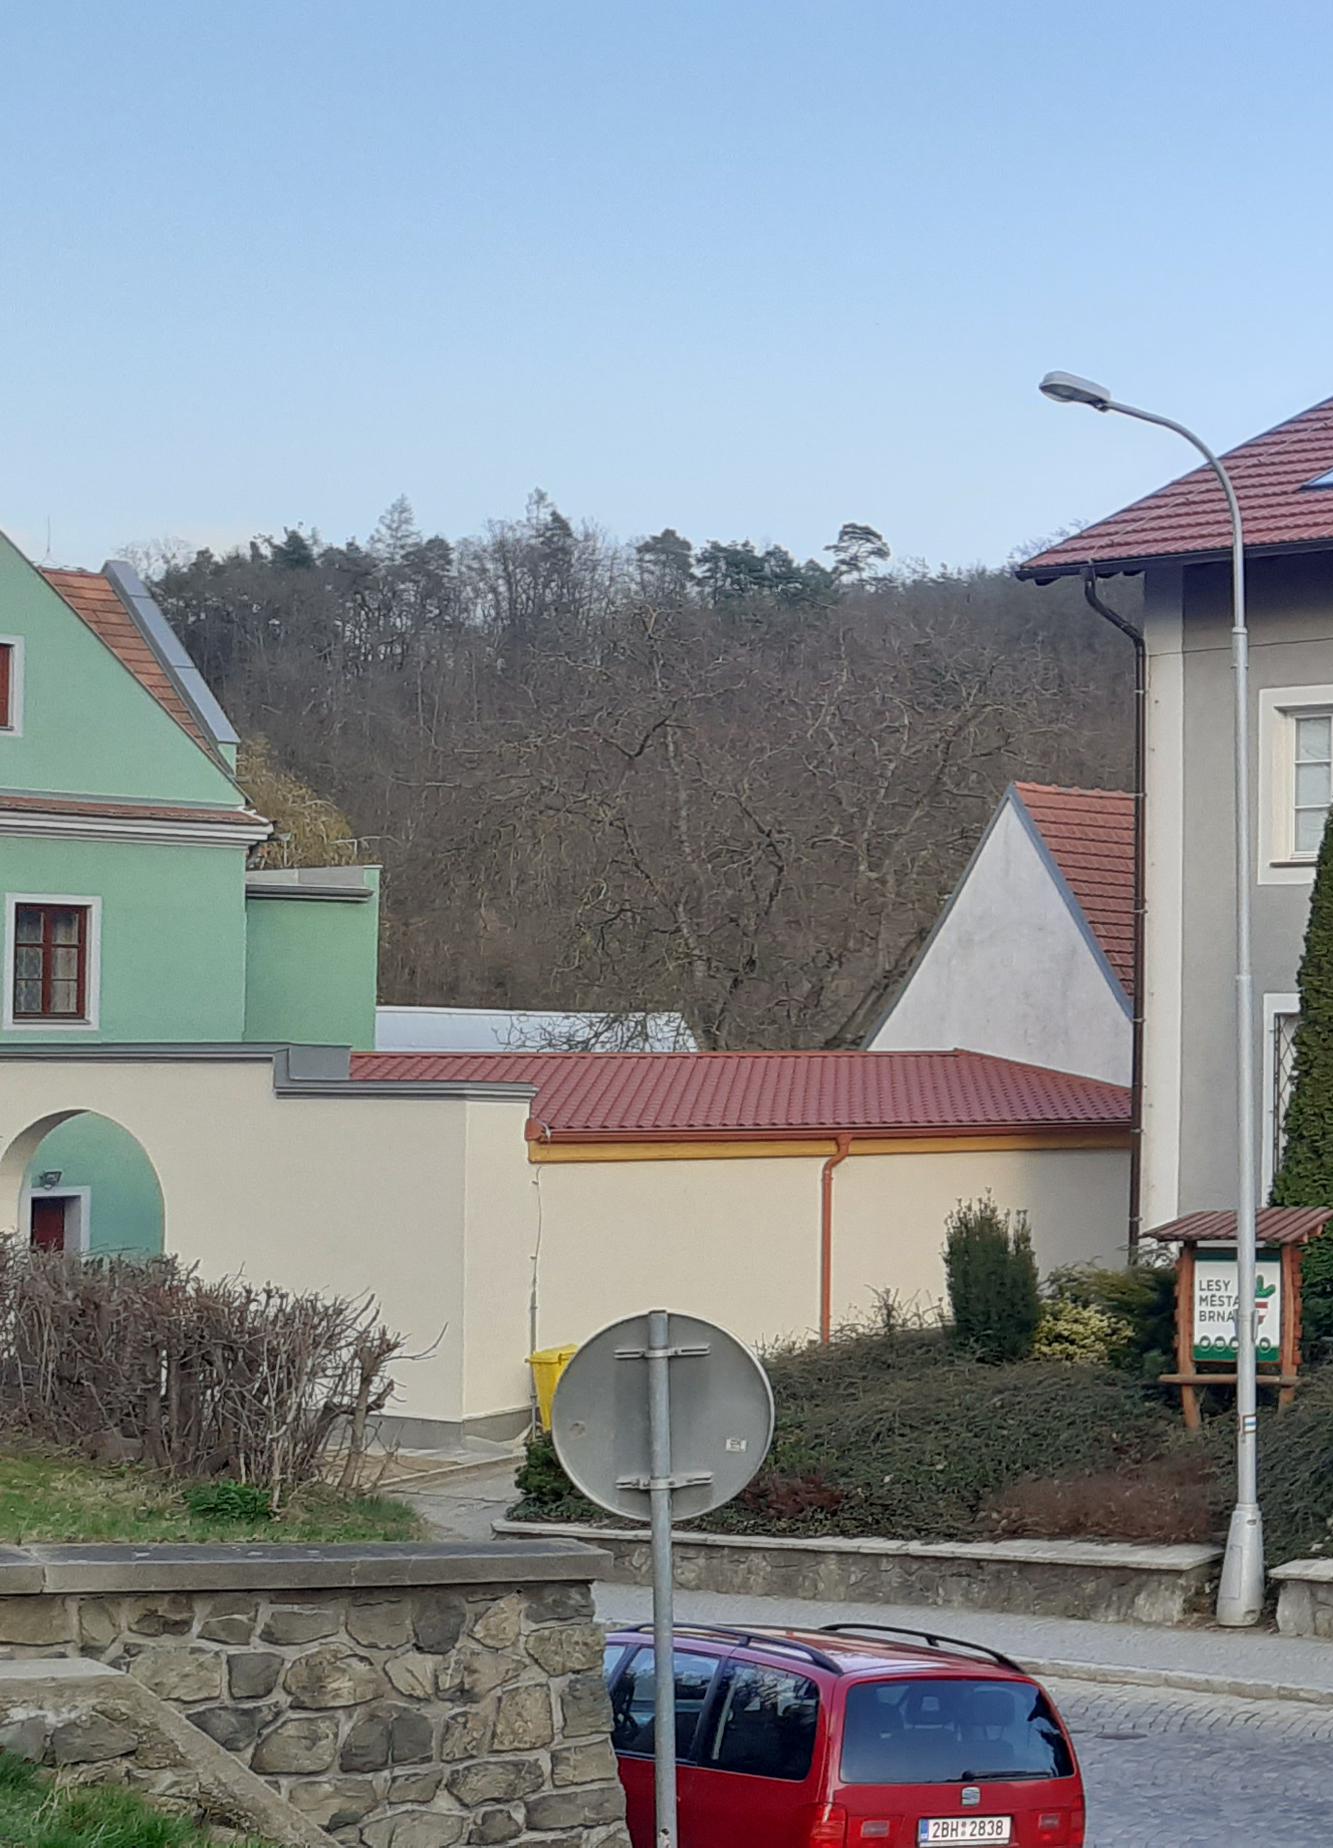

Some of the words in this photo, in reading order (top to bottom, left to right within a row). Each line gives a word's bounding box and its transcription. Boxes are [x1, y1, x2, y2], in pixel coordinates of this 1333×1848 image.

[1199, 1279, 1231, 1292] LESY
[932, 1821, 959, 1838] 2BH
[969, 1820, 1003, 1837] 2838
